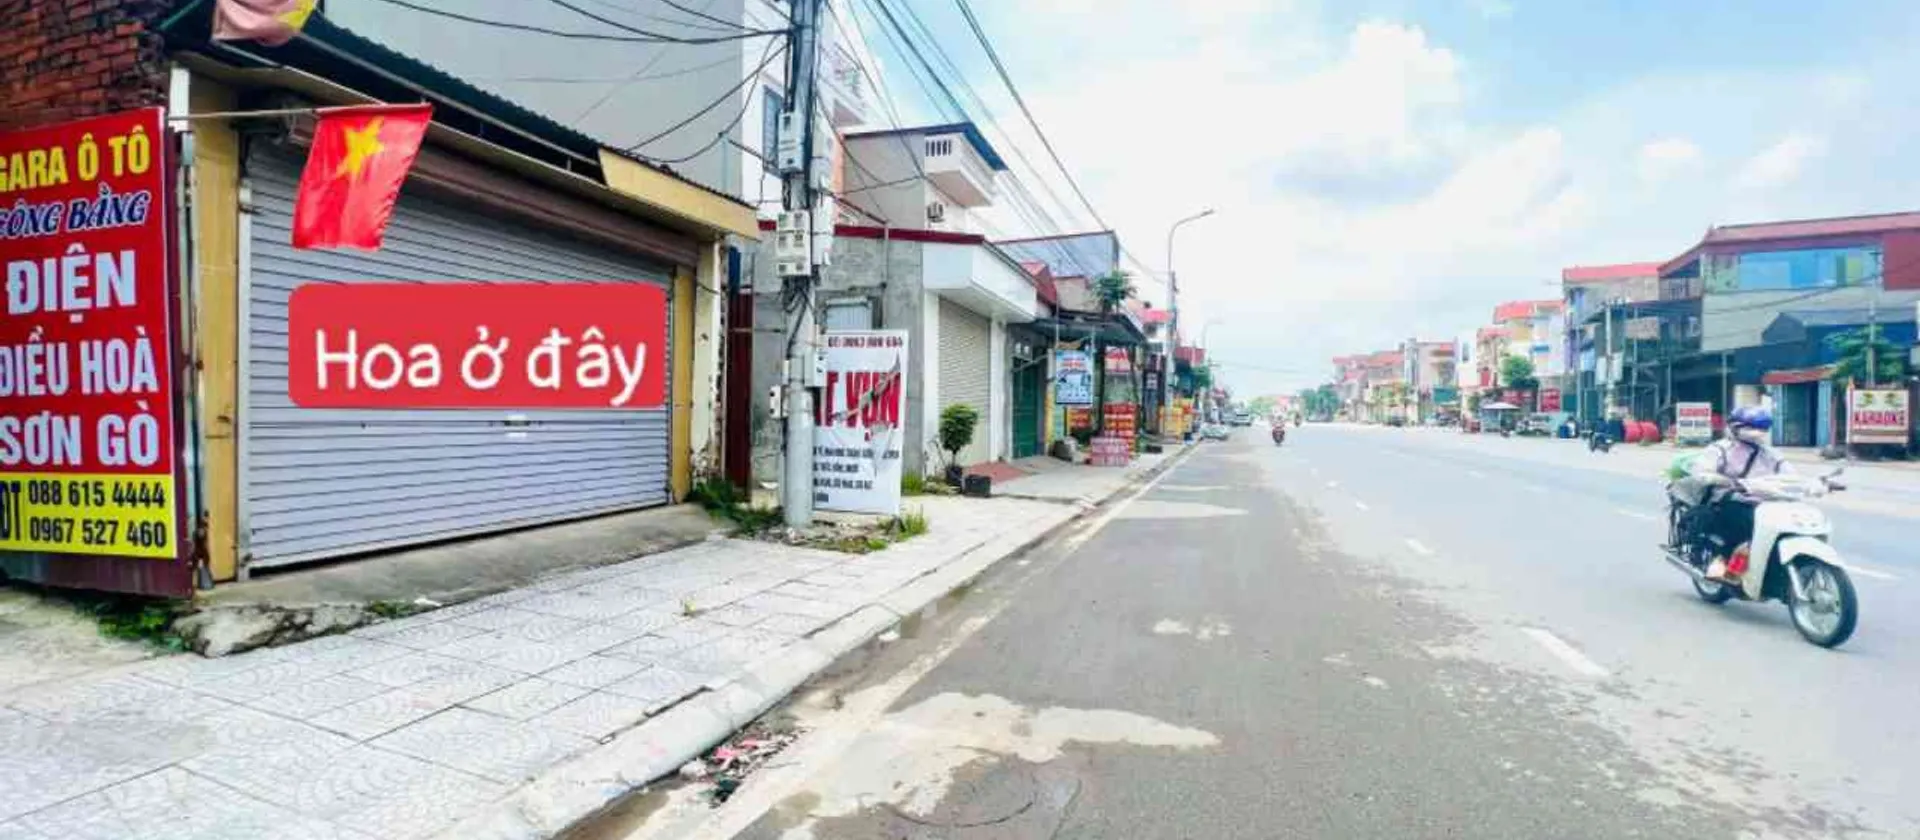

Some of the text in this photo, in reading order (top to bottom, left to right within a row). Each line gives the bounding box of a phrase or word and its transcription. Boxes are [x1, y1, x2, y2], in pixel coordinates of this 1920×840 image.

[77, 132, 99, 181] Ô
[108, 124, 151, 176] TÔ
[67, 181, 151, 231] BẰNG
[7, 243, 136, 323] ĐIỆN
[80, 325, 159, 395] HOÀ
[0, 400, 159, 466] SƠN GÒ
[28, 480, 62, 506] 088
[68, 480, 106, 508] 615
[112, 481, 166, 510] 4444
[29, 516, 168, 548] 0967 527 460
